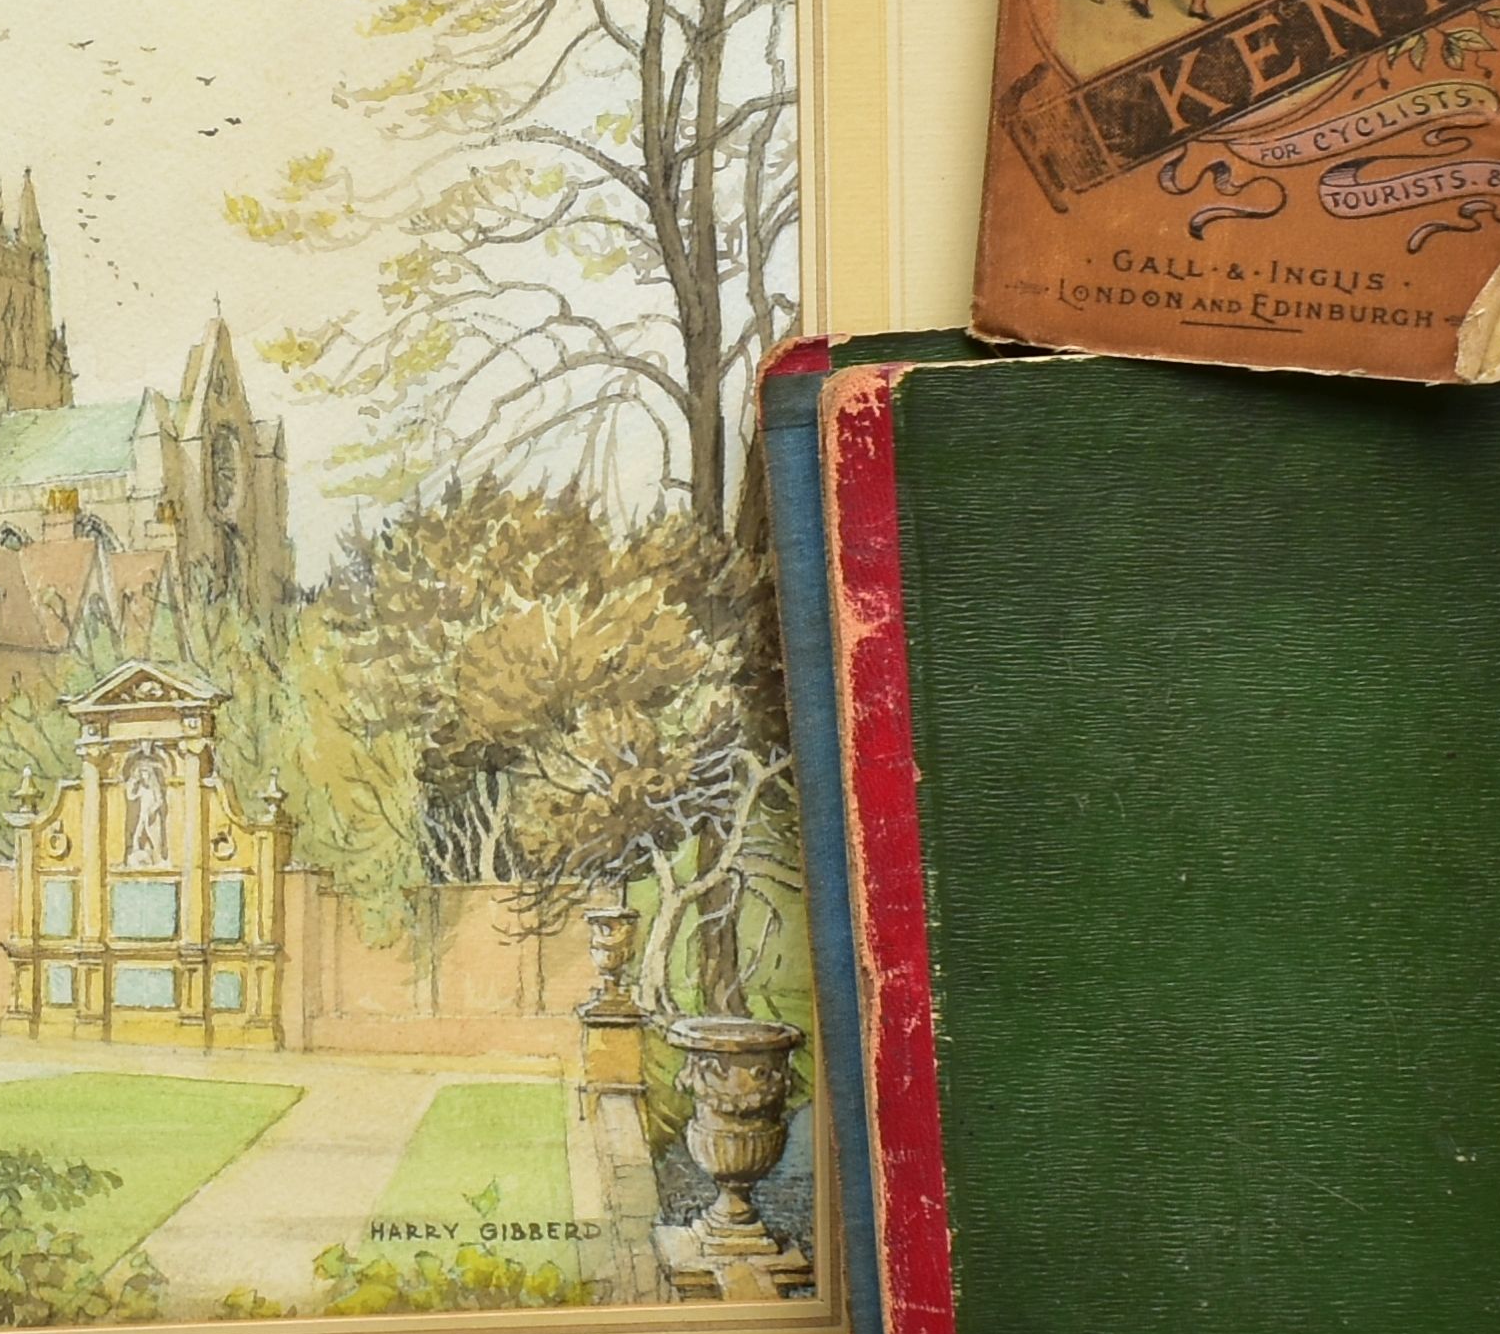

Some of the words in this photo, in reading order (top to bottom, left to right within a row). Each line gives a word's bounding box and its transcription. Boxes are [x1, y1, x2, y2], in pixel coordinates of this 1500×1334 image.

[1260, 143, 1300, 161] FOR
[1113, 248, 1204, 282] GALL
[1227, 264, 1244, 280] &
[1271, 261, 1385, 294] INGLIS
[1057, 278, 1183, 312] LONDON
[1195, 296, 1242, 314] AND
[1251, 293, 1434, 328] EDINBURGH
[370, 1221, 459, 1241] HARRY
[479, 1221, 602, 1242] GIBBERD
